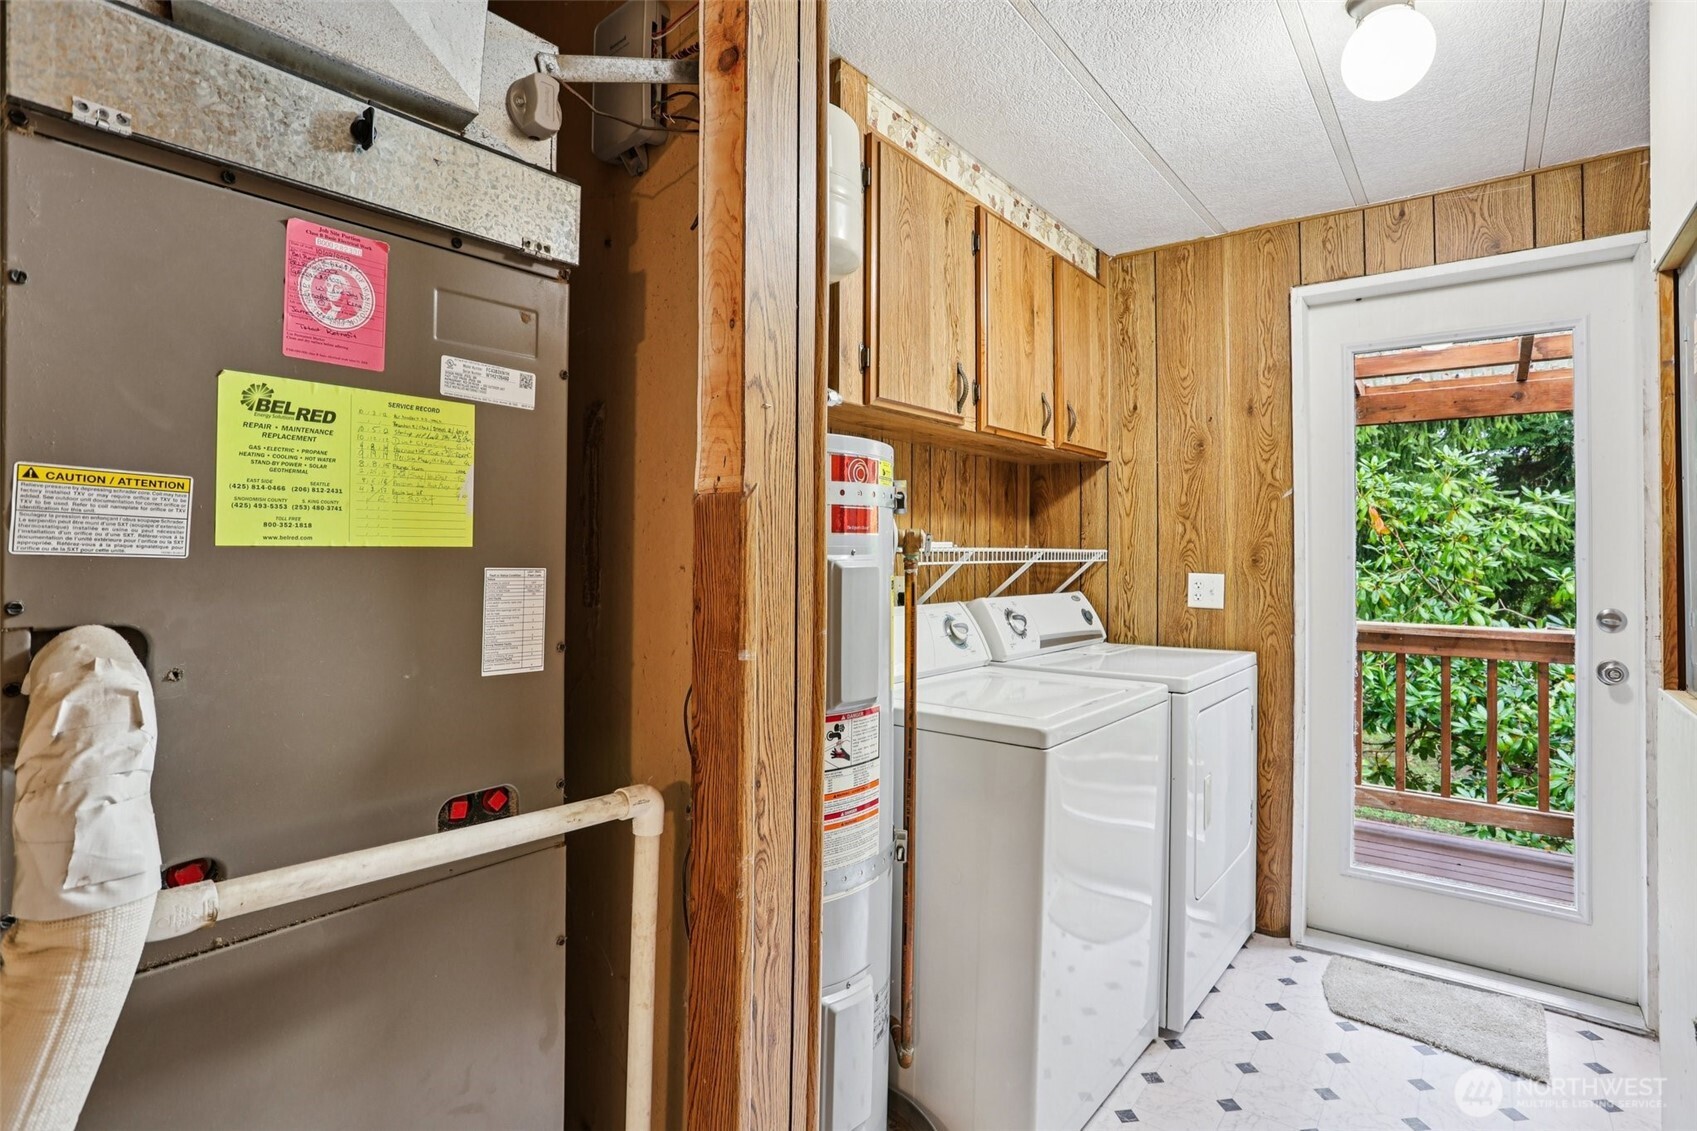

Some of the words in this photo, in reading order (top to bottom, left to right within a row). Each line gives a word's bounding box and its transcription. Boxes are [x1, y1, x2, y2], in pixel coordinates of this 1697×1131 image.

[388, 402, 414, 411] SERVICE
[242, 421, 271, 429] REPAIR
[281, 425, 333, 435] MAINTENANCE
[261, 432, 316, 441] REPLACEMENT
[45, 471, 105, 483] CAUTION
[109, 476, 114, 484] /
[117, 477, 184, 489] ATTENTION
